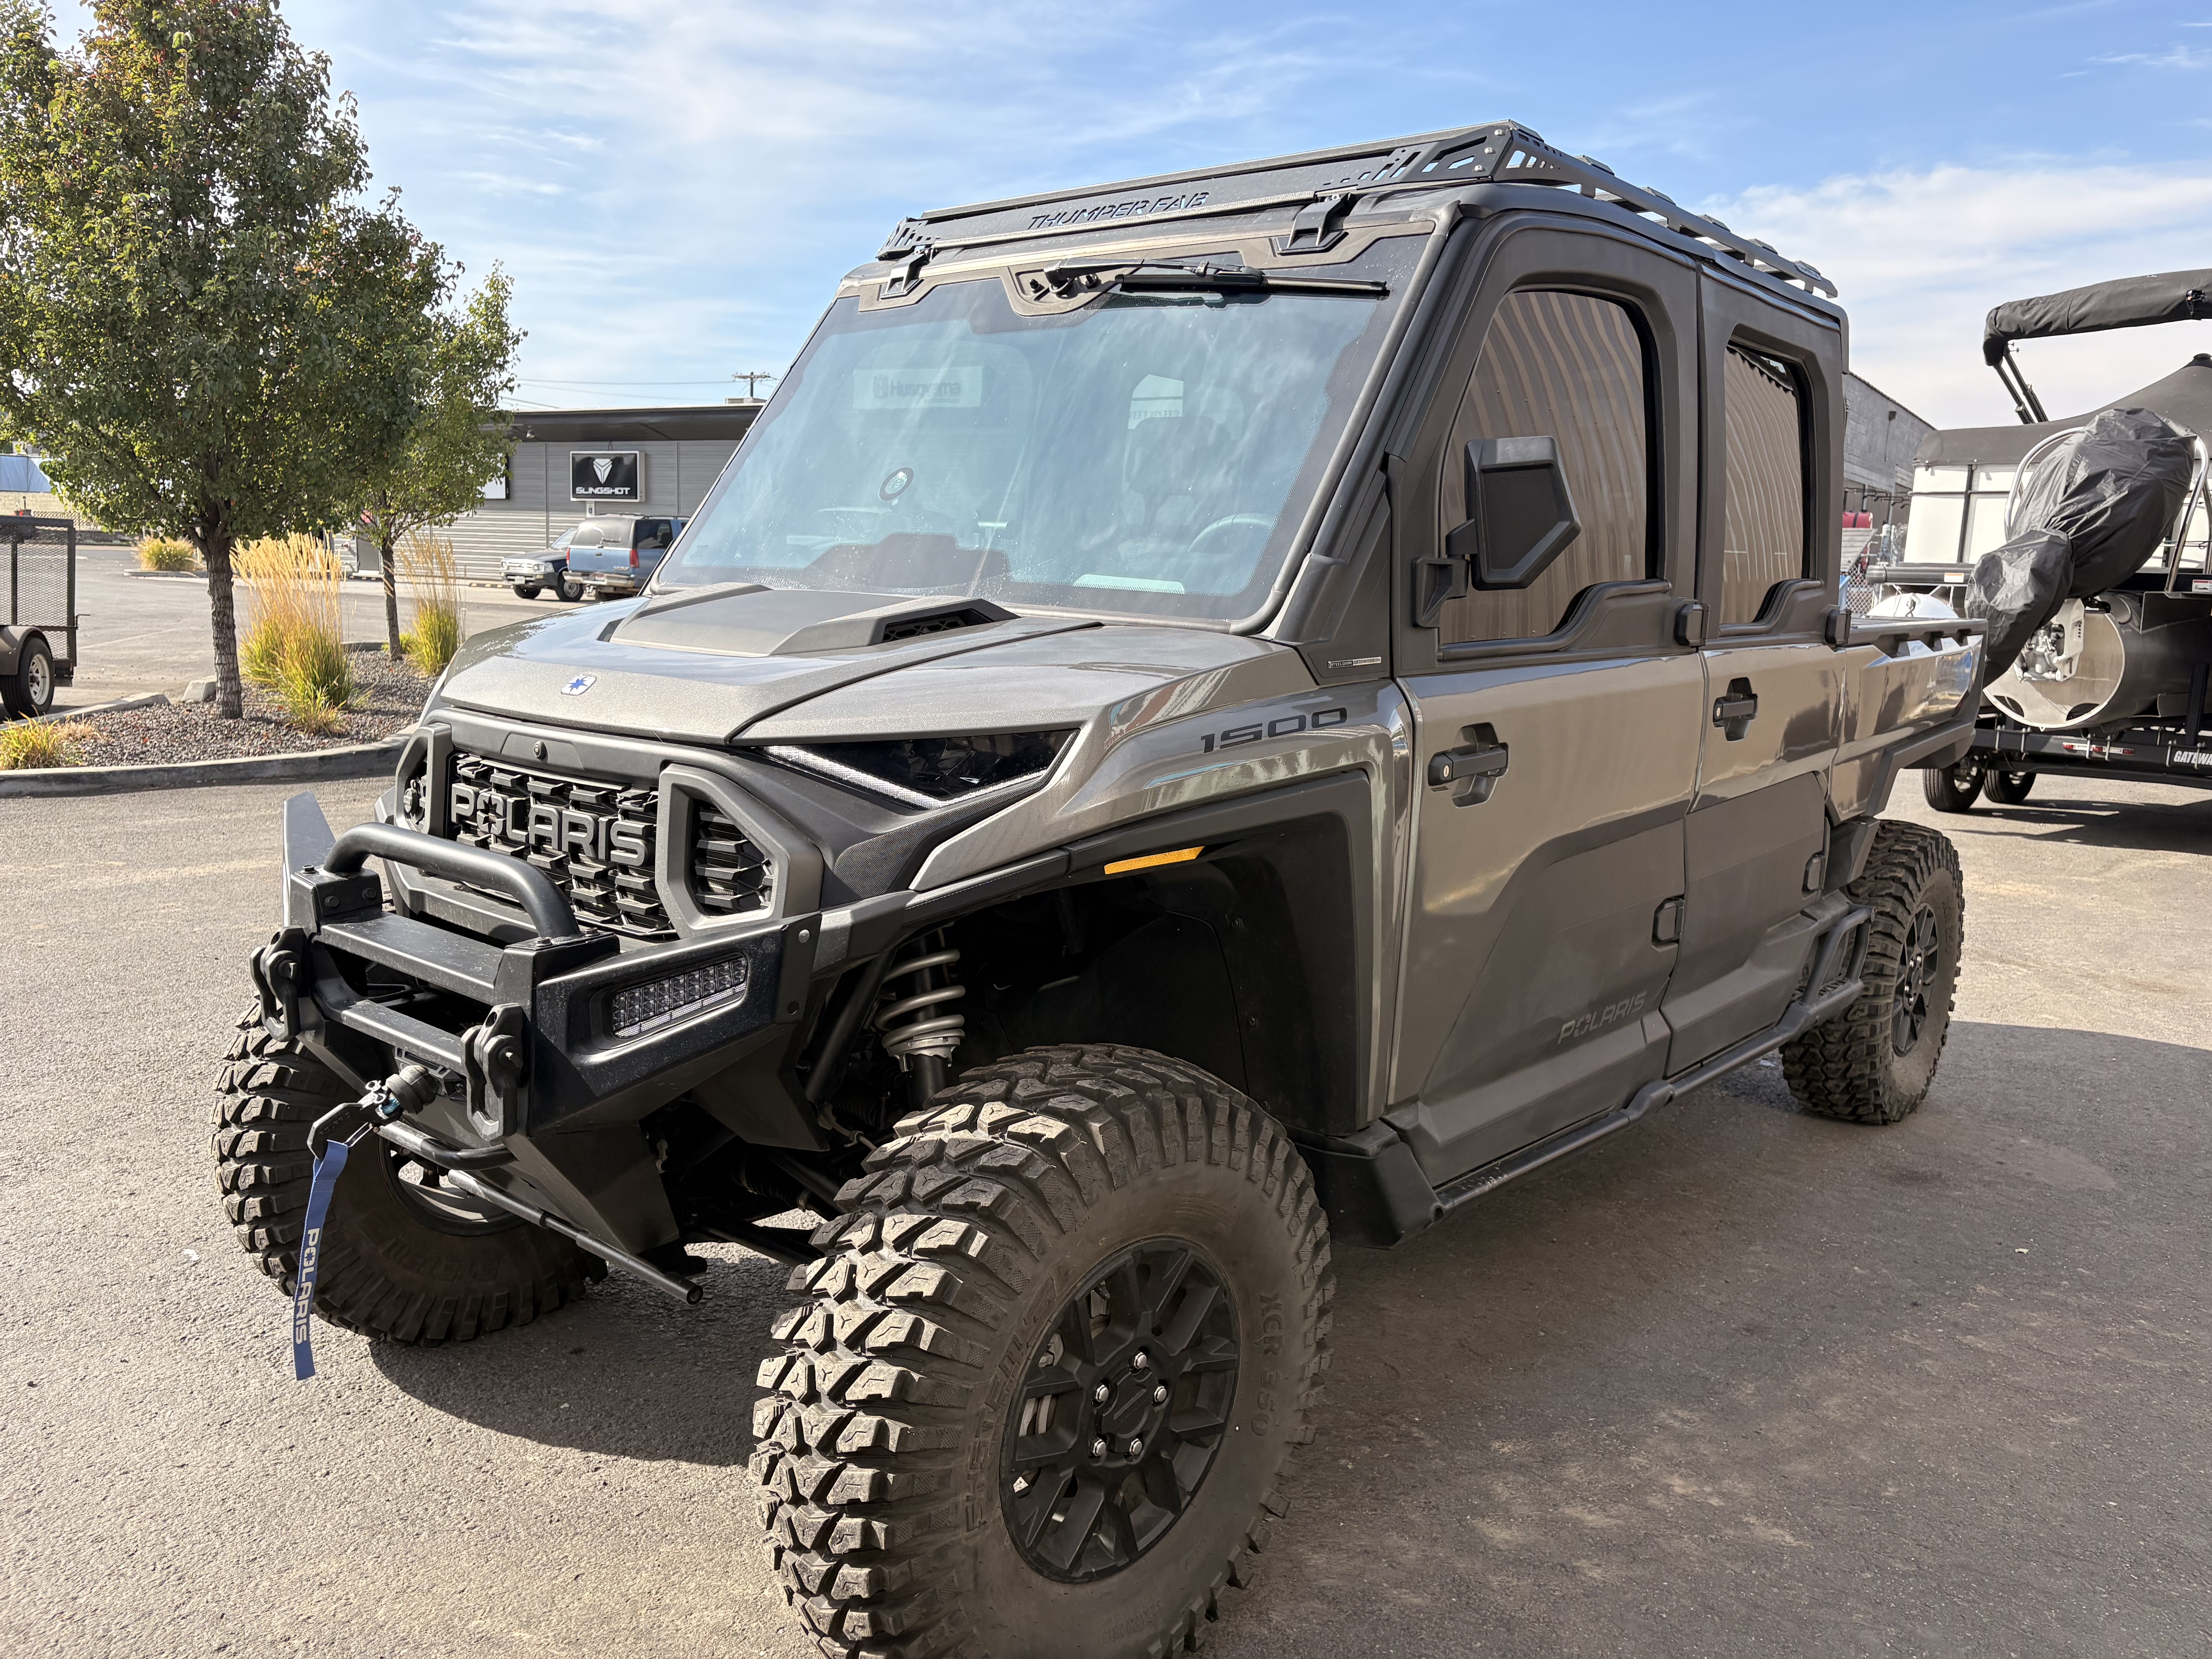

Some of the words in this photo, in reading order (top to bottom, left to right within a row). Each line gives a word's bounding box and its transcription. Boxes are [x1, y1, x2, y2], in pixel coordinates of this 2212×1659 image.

[1027, 200, 1149, 230] THUMPER
[1149, 192, 1209, 213] FAB
[575, 486, 630, 495] SLINGSHOT
[1200, 707, 1347, 754] 1500
[451, 782, 648, 867] POLARIS
[1557, 991, 1647, 1046] POLARIS
[295, 1228, 320, 1345] POLARIS
[1259, 1290, 1284, 1355] XCR
[1250, 1371, 1279, 1437] 350
